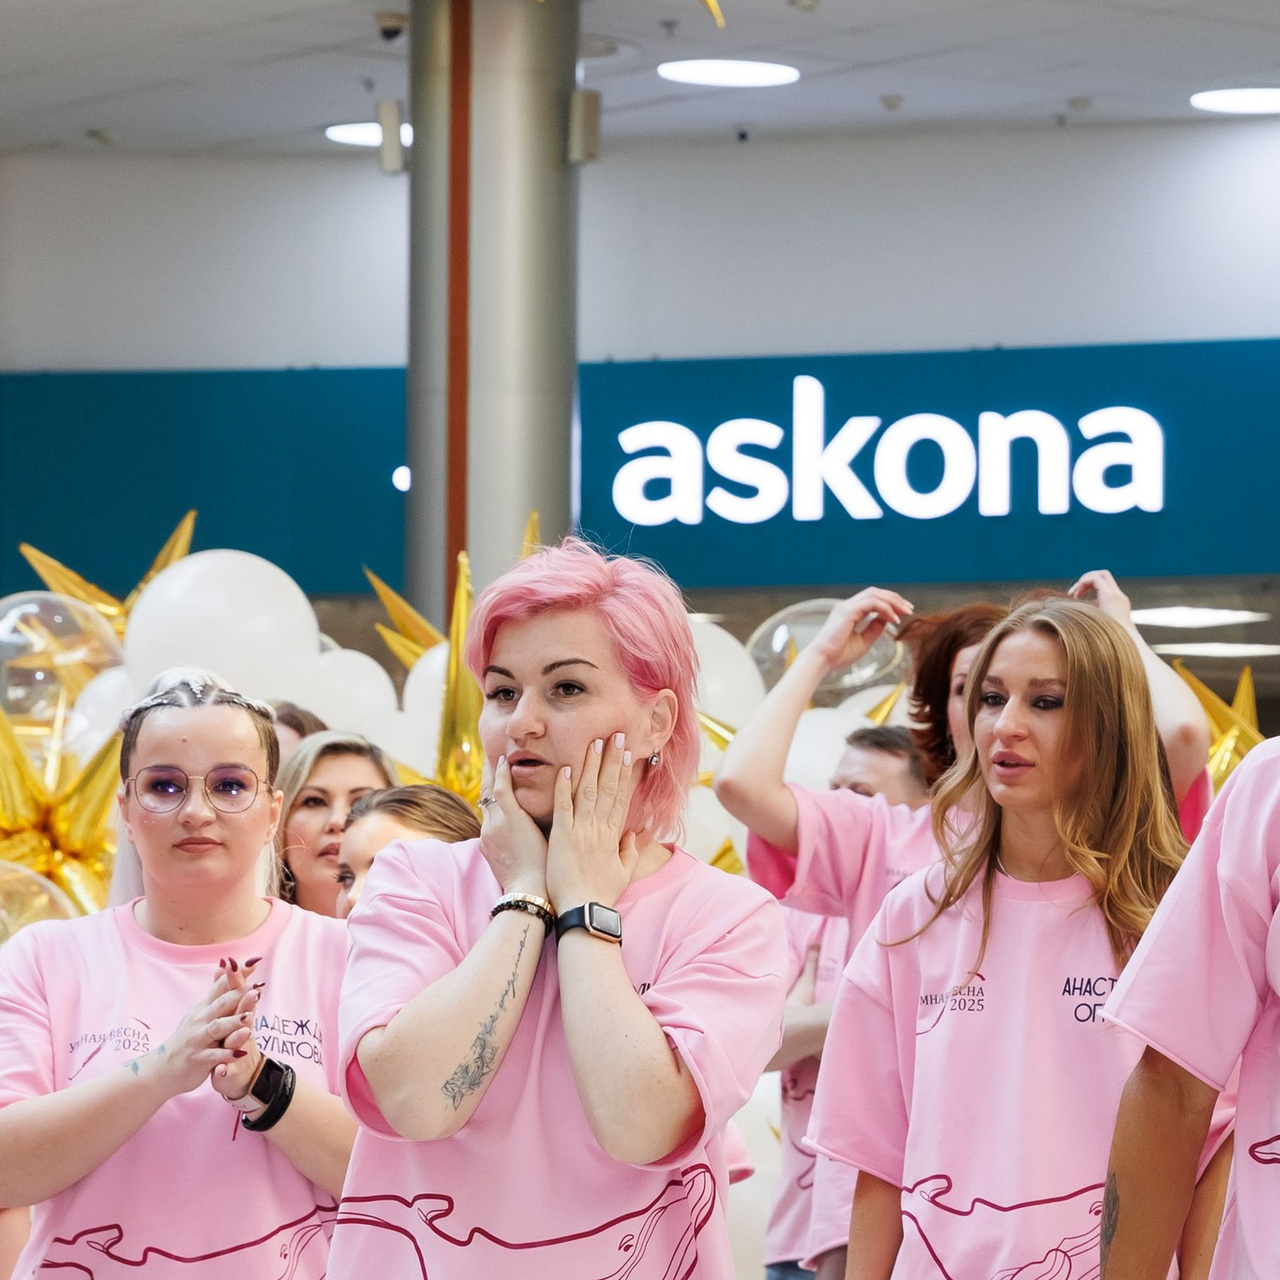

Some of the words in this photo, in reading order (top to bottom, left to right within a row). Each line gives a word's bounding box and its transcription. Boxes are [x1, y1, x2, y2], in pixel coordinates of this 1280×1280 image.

[611, 374, 1165, 526] askona
[1061, 976, 1119, 997] АНАСТ
[950, 998, 985, 1012] 2025
[114, 1038, 150, 1053] 2025
